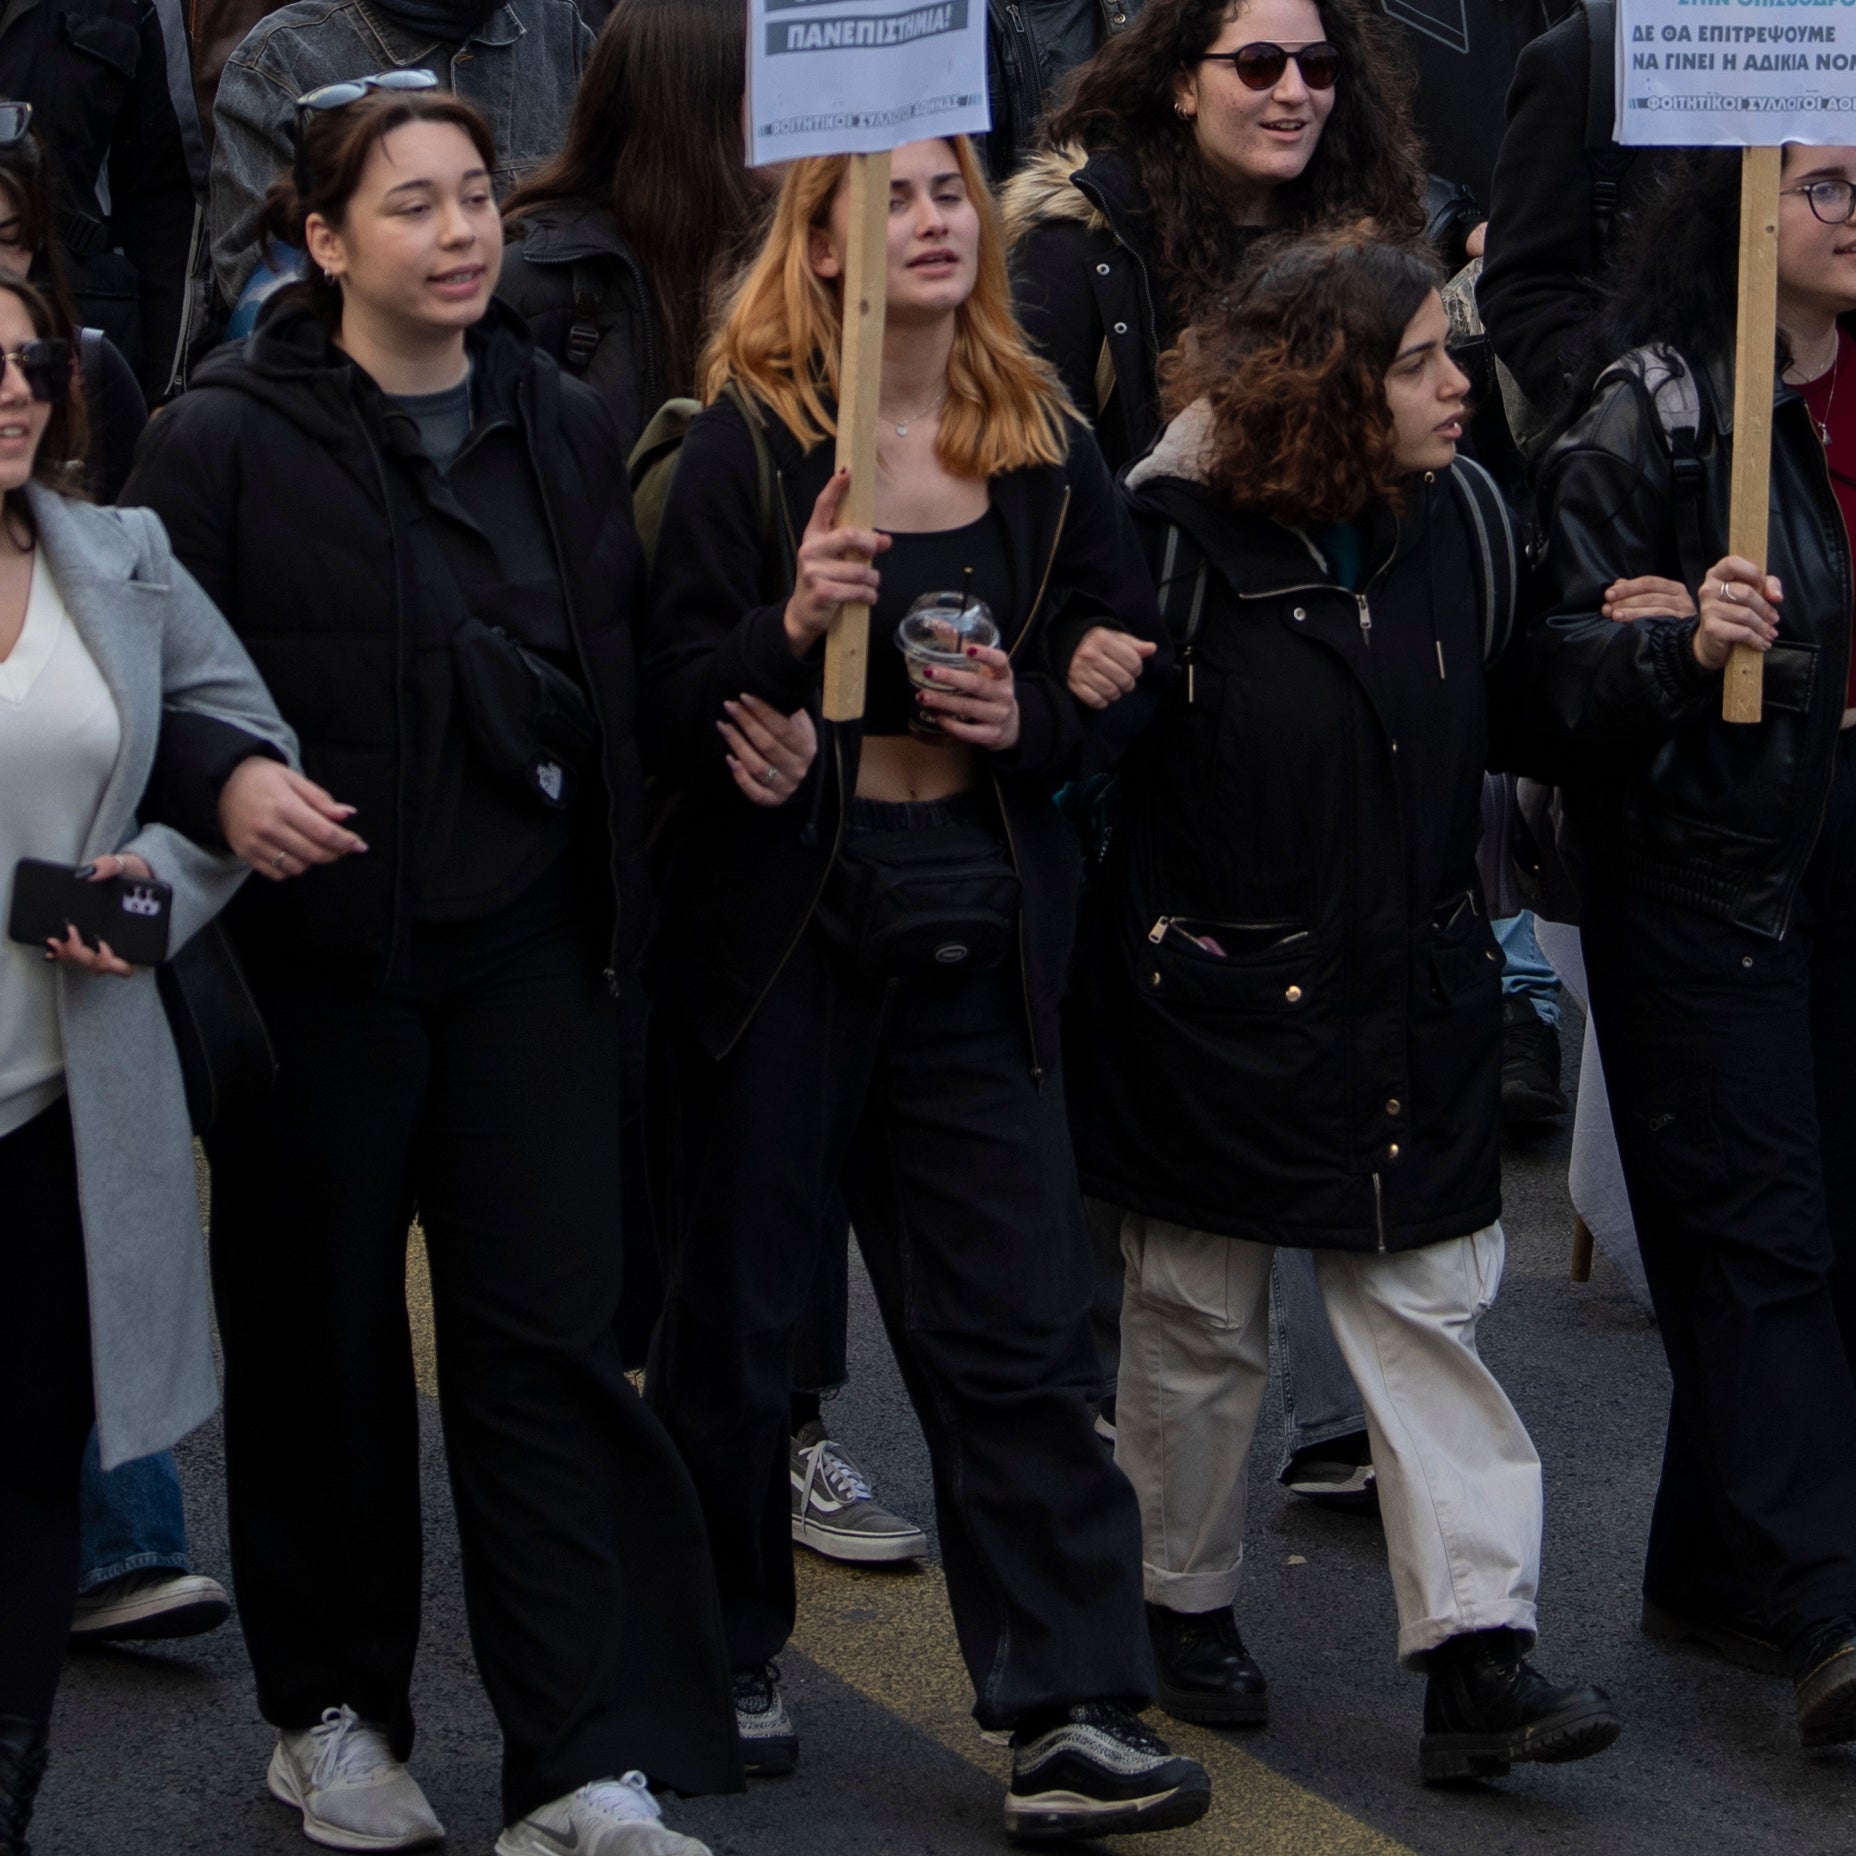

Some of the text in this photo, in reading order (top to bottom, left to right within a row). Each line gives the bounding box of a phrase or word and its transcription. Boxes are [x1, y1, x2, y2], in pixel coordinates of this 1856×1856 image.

[786, 4, 953, 49] ΠΑΝΕΠΙΣΤΗΜΙΑ!
[1632, 24, 1836, 44] ΔΕ ΘΑ ΕΠΙΤΡΕΨΟΥΜΕ
[1632, 53, 1660, 71] ΝΑ
[1665, 53, 1715, 71] ΓΙΝΕΙ
[1722, 53, 1737, 71] Η
[1744, 53, 1809, 72] ΑΔΙΚΙΑ
[1646, 93, 1744, 112] ΦΟΙΤΗΤΙΚΟΙ
[1746, 93, 1823, 112] ΣΥΛΛΟΓΟΙ
